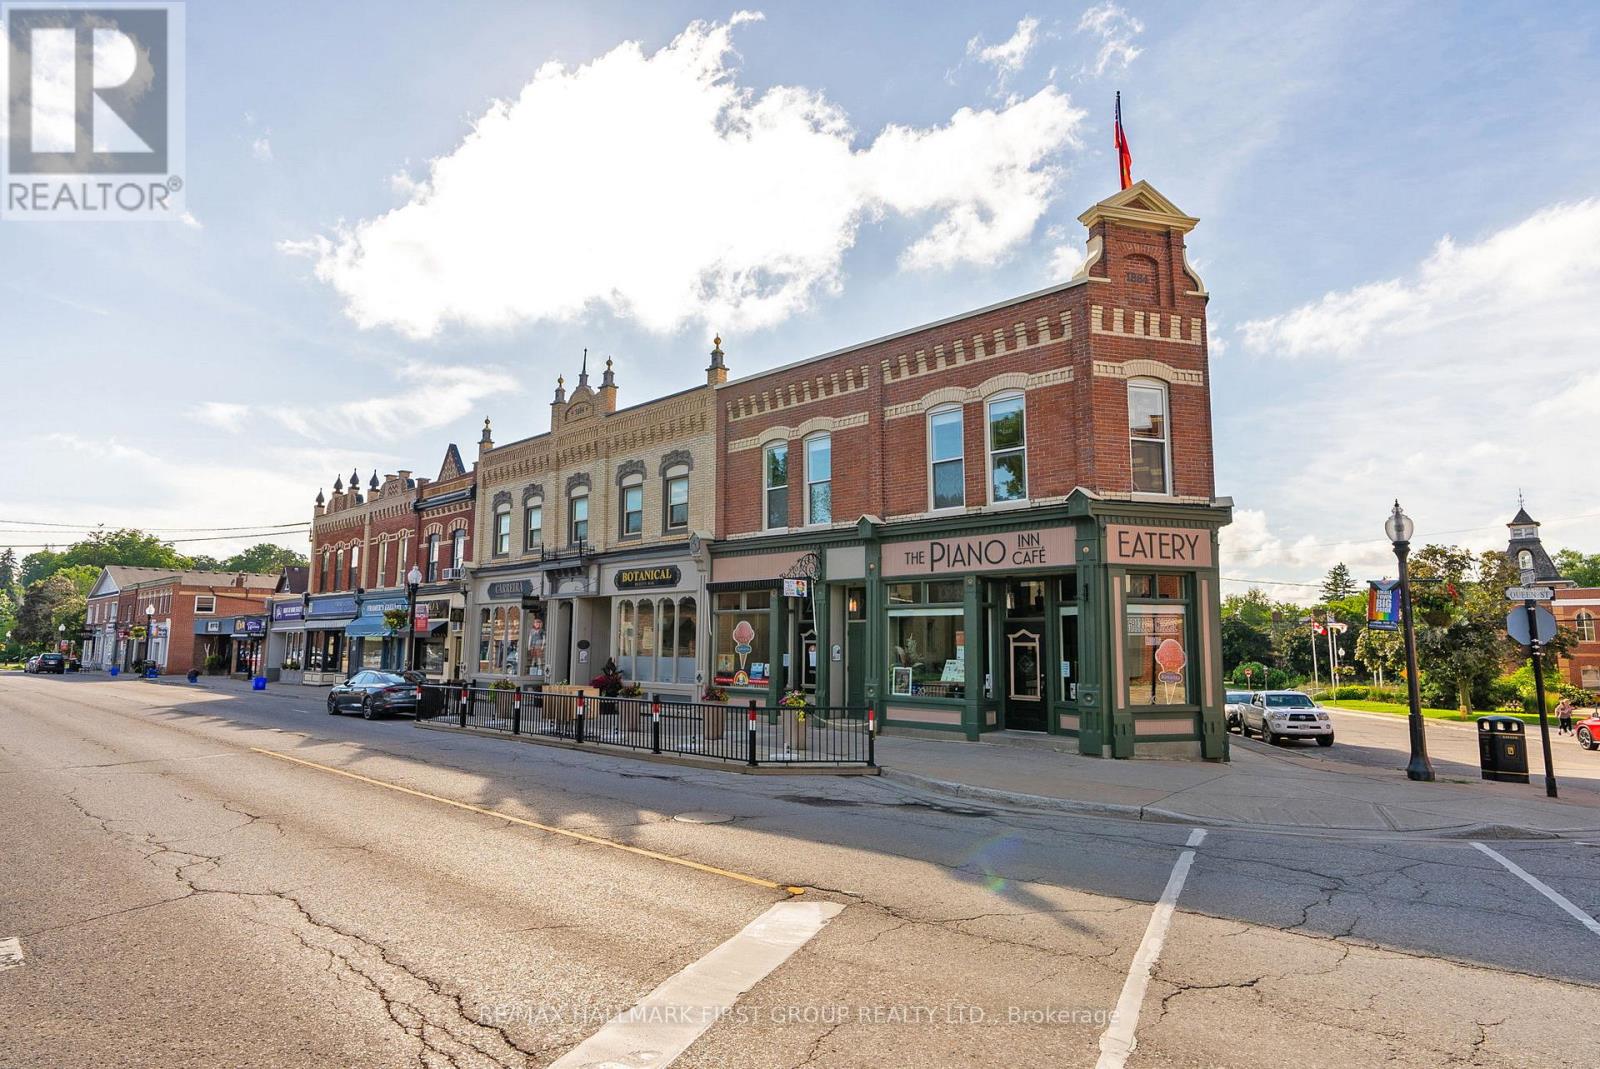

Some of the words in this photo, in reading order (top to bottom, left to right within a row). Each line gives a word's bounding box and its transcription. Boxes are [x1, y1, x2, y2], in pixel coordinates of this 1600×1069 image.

[1017, 532, 1040, 547] INN
[1118, 531, 1199, 561] EATERY
[904, 551, 925, 565] THE
[930, 540, 1006, 572] PIANO
[1012, 547, 1046, 565] CAFÉ
[622, 568, 672, 582] BOTANICAL
